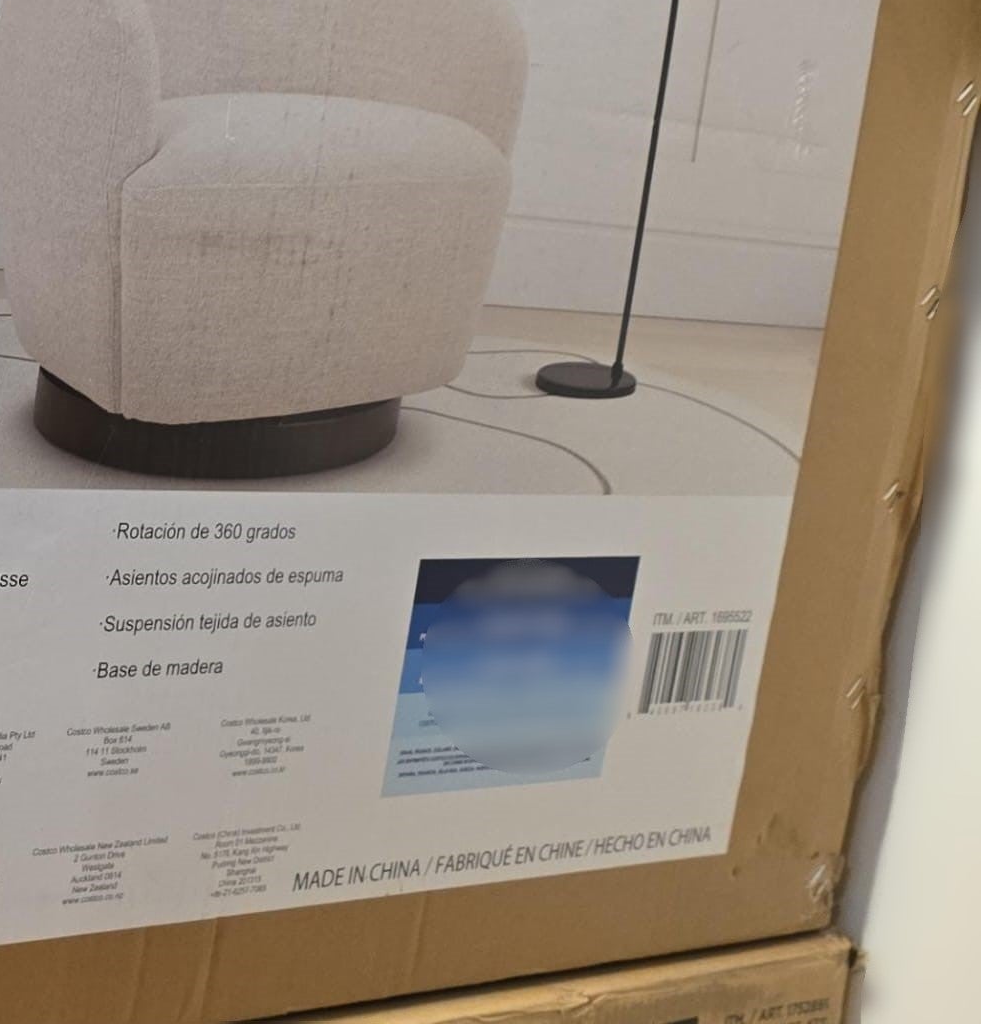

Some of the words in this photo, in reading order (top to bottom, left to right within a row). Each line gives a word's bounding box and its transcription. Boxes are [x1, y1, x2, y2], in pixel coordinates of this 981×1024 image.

[190, 524, 209, 539] de
[214, 523, 242, 539] 360
[246, 524, 296, 543] grados
[182, 568, 261, 589] acojinados
[266, 569, 284, 583] de
[288, 569, 344, 586] espuma
[199, 612, 238, 633] tejida
[244, 612, 261, 628] de
[265, 612, 316, 627] asiento
[142, 660, 161, 676] de
[166, 659, 223, 675] madera
[292, 863, 345, 892] MADE
[348, 864, 366, 885] IN
[369, 858, 420, 883] CHINA
[435, 844, 513, 875] FABRIQUÉ
[515, 847, 537, 865] EN
[538, 839, 583, 862] CHINE
[594, 833, 645, 857] HECHO
[646, 831, 666, 849] EN
[668, 825, 712, 848] CHINA
